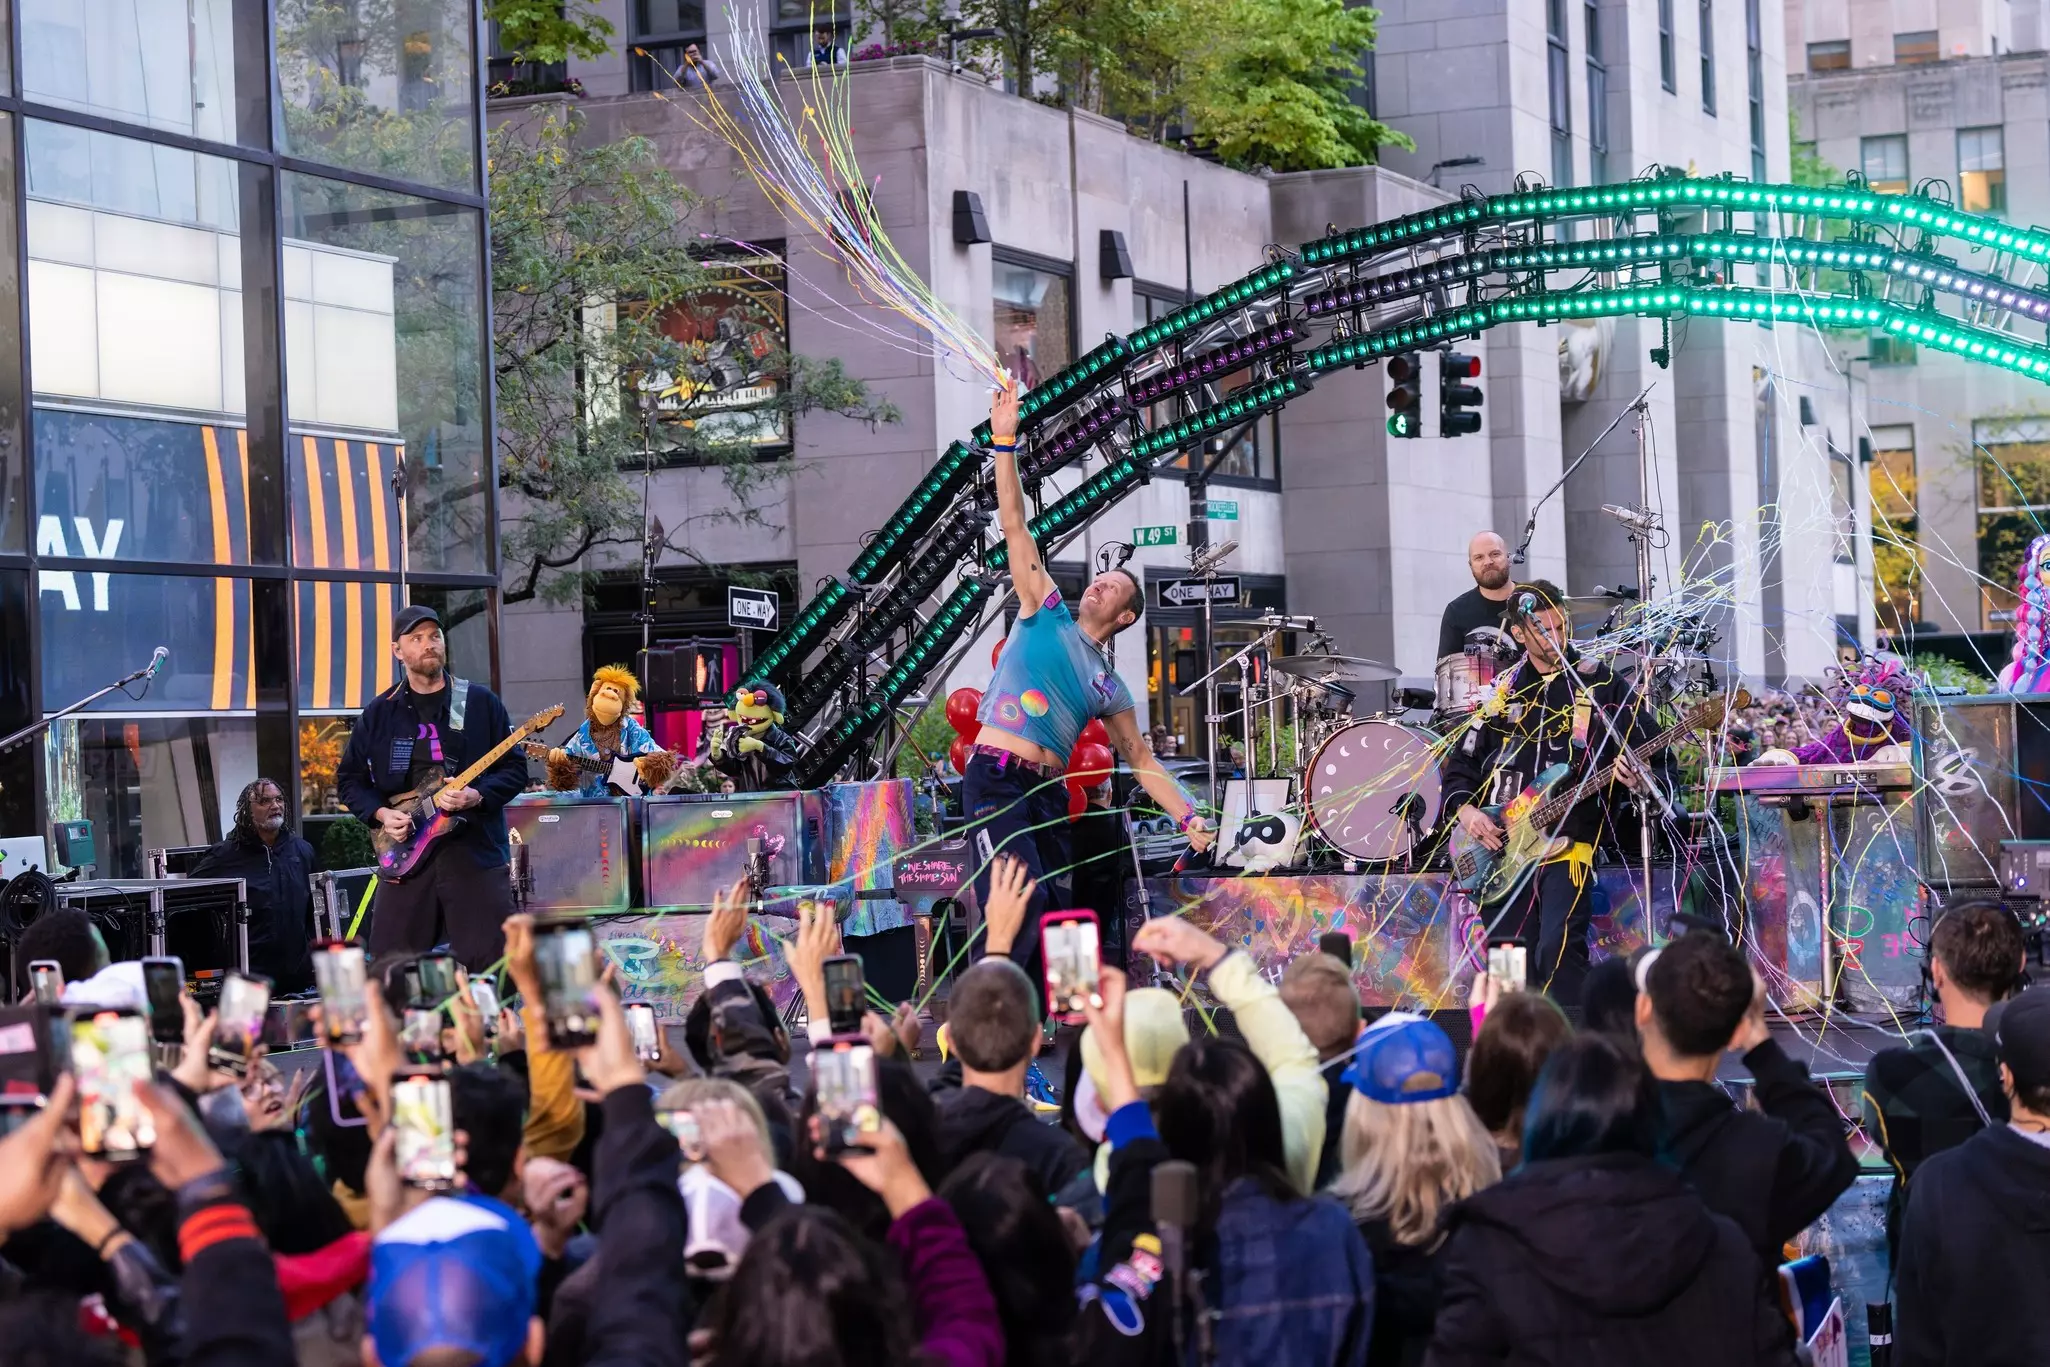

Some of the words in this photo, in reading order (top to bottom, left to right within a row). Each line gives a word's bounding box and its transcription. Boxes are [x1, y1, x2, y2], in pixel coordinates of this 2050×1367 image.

[1136, 529, 1145, 545] W
[1148, 528, 1161, 544] 49
[1164, 527, 1174, 537] ST
[37, 515, 124, 611] AY
[1171, 587, 1194, 599] ONE
[737, 600, 751, 615] ONE
[757, 603, 771, 618] WAY
[908, 861, 923, 873] WE
[898, 872, 914, 885] THE
[940, 869, 957, 885] SUN
